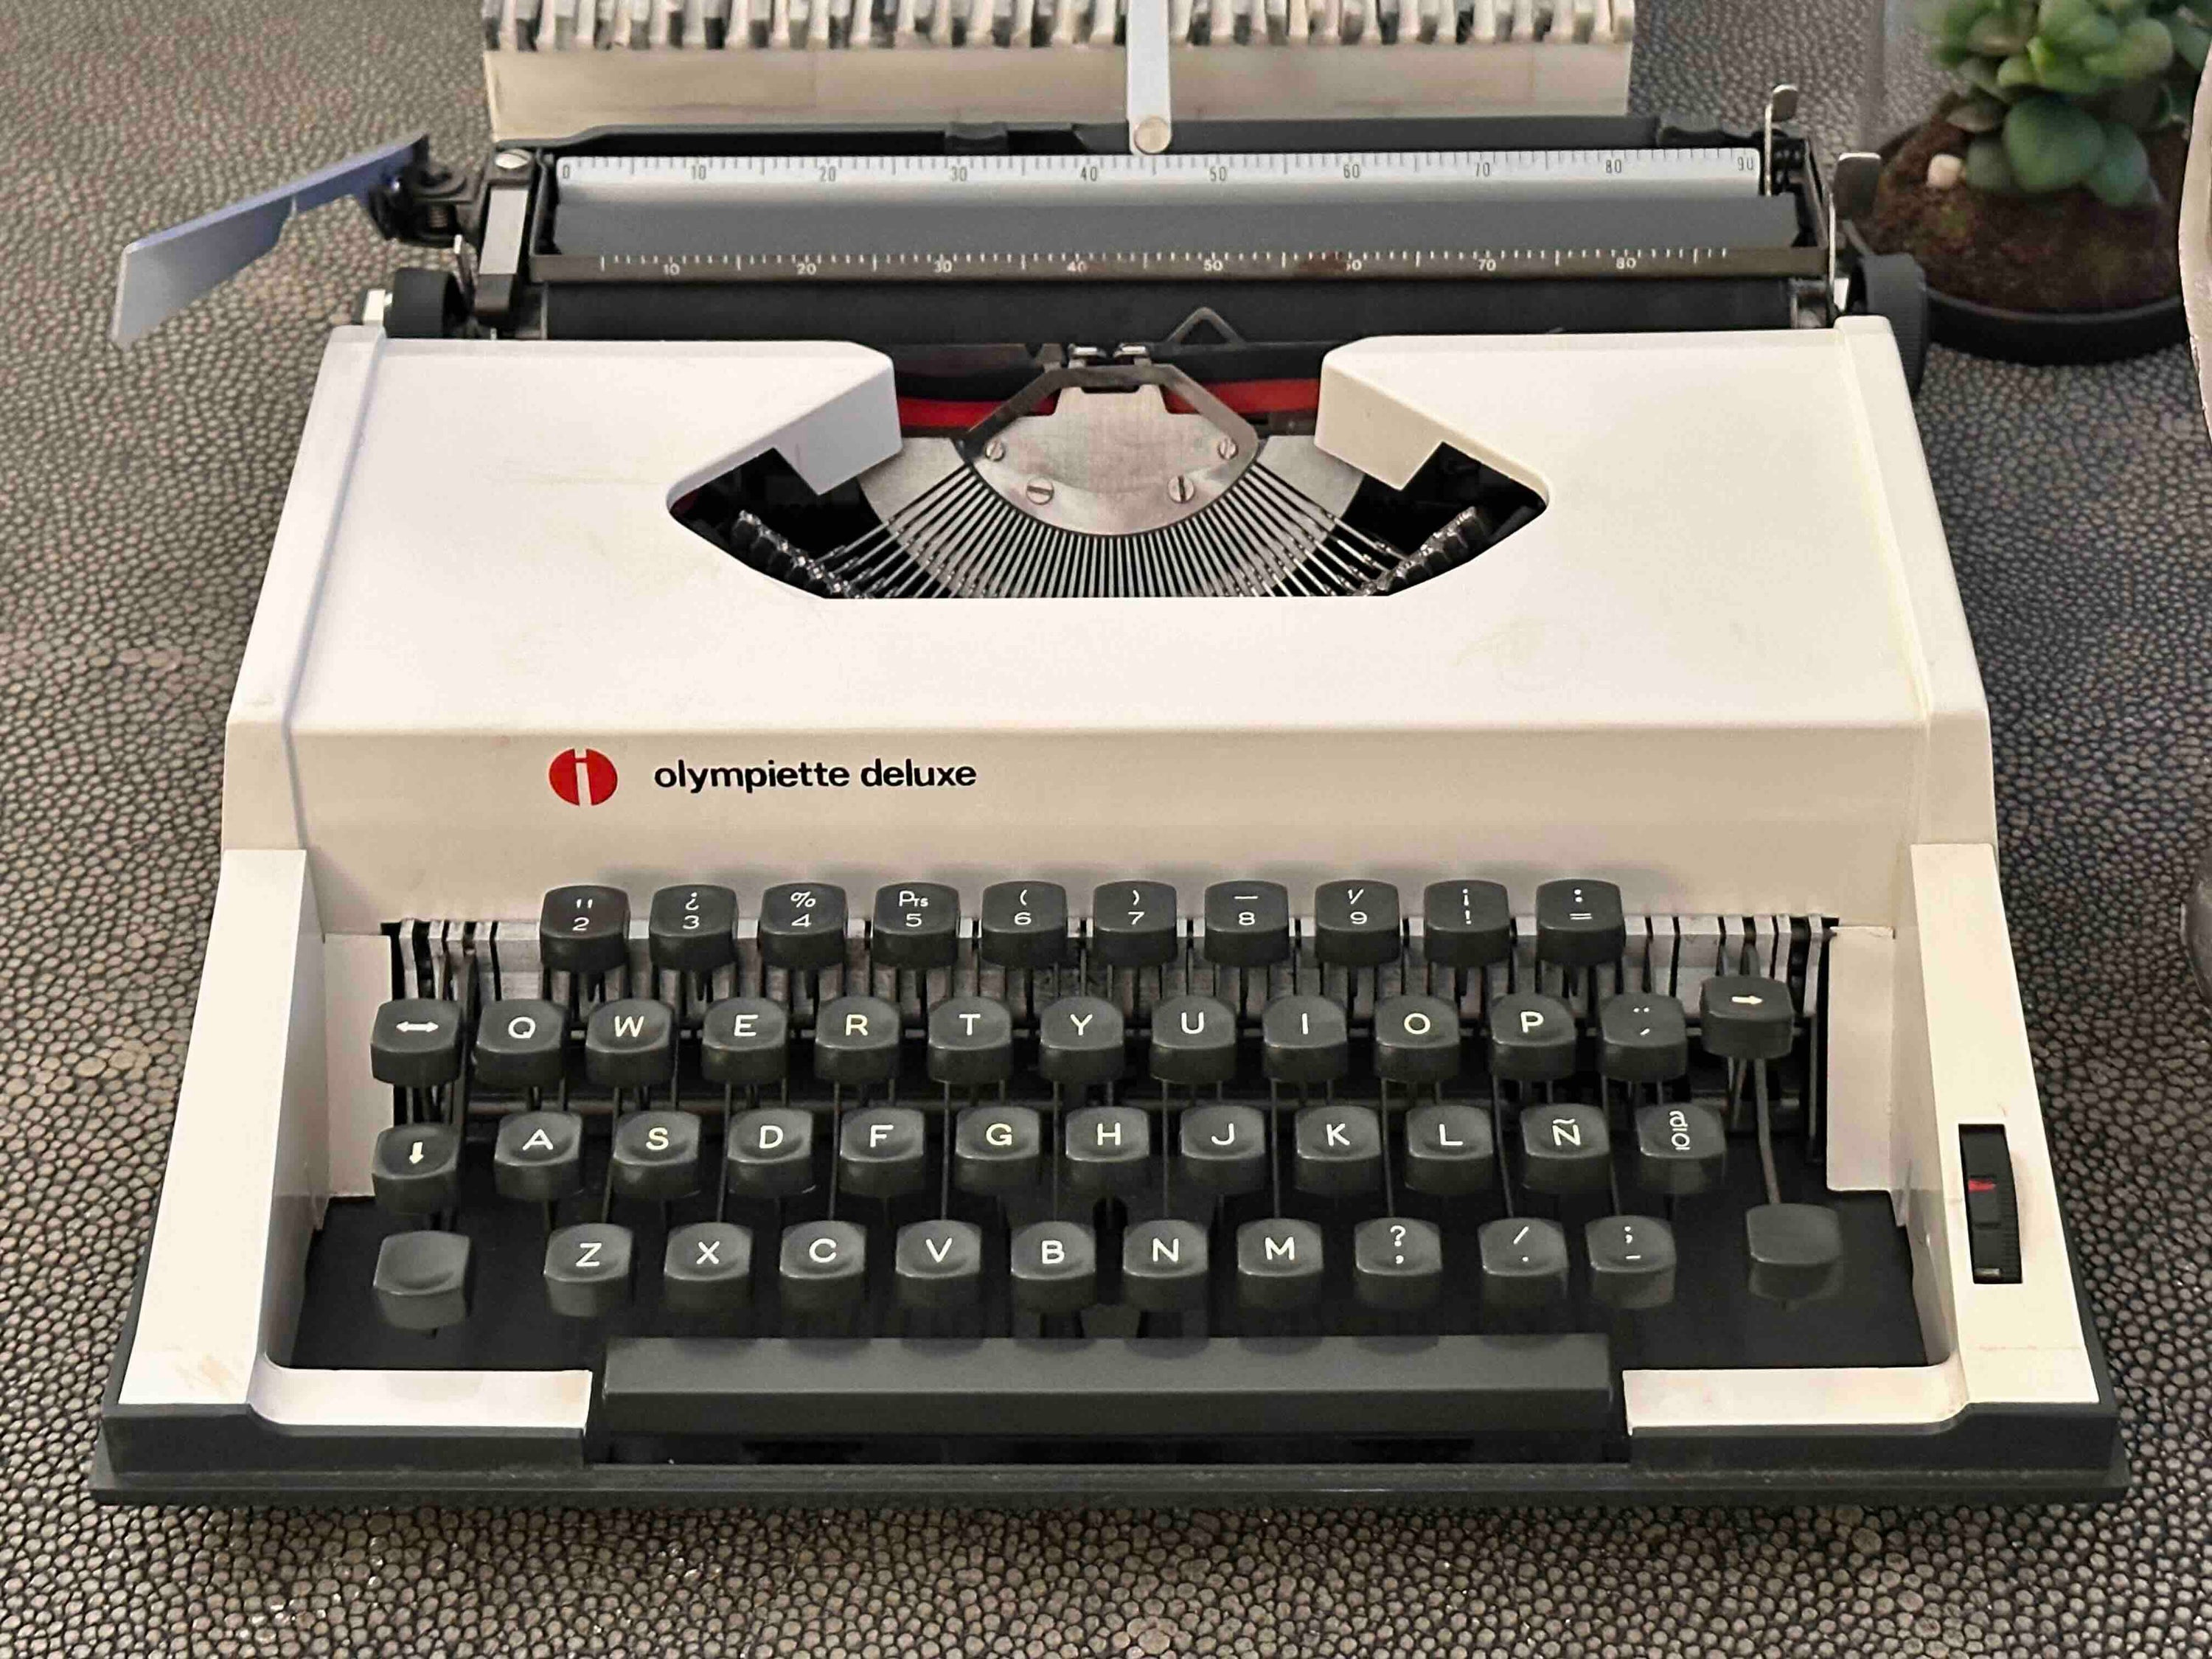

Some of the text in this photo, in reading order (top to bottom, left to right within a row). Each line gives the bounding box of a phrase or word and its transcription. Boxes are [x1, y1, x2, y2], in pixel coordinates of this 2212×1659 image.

[562, 156, 1755, 182] 0 10 20 30 40 50 60 70 80 90
[663, 262, 680, 275] 10
[798, 262, 817, 274] 20
[935, 260, 953, 273] 30
[1203, 258, 1222, 271] 50
[1478, 258, 1497, 271] 70
[1616, 257, 1637, 270] 80
[654, 758, 977, 794] olympiette deluxe
[790, 891, 816, 908] %
[1020, 889, 1028, 906] (
[1133, 889, 1140, 905] )
[572, 917, 590, 931] 2
[683, 915, 700, 930] 3
[791, 914, 812, 928] 4
[905, 913, 922, 928] 5
[1014, 911, 1032, 925] 6
[1128, 911, 1145, 925] 7
[1239, 911, 1256, 926] 8
[1350, 911, 1368, 925] 9
[1465, 910, 1472, 925] !
[508, 1017, 536, 1039] Q
[614, 1015, 644, 1037] W
[734, 1014, 759, 1037] E
[845, 1014, 869, 1036] R
[959, 1013, 981, 1036] T
[1070, 1013, 1093, 1036] Y
[1181, 1012, 1205, 1034] U
[1301, 1012, 1309, 1035] I
[1404, 1012, 1431, 1035] O
[1520, 1011, 1544, 1033] P
[522, 1128, 554, 1151] A
[645, 1127, 669, 1150] S
[759, 1125, 784, 1149] D
[870, 1124, 894, 1148] F
[986, 1123, 1012, 1146] G
[1097, 1122, 1121, 1146] H
[1211, 1123, 1235, 1146] J
[1326, 1123, 1350, 1147] K
[1439, 1124, 1464, 1146] L
[1552, 1119, 1581, 1146] Ñ
[1390, 1225, 1406, 1247] ?
[1513, 1226, 1529, 1245] /
[576, 1242, 602, 1267] Z
[696, 1241, 720, 1265] X
[809, 1238, 837, 1263] C
[925, 1237, 953, 1263] V
[1041, 1239, 1065, 1265] B
[1152, 1238, 1179, 1262] N
[1265, 1237, 1295, 1261] M
